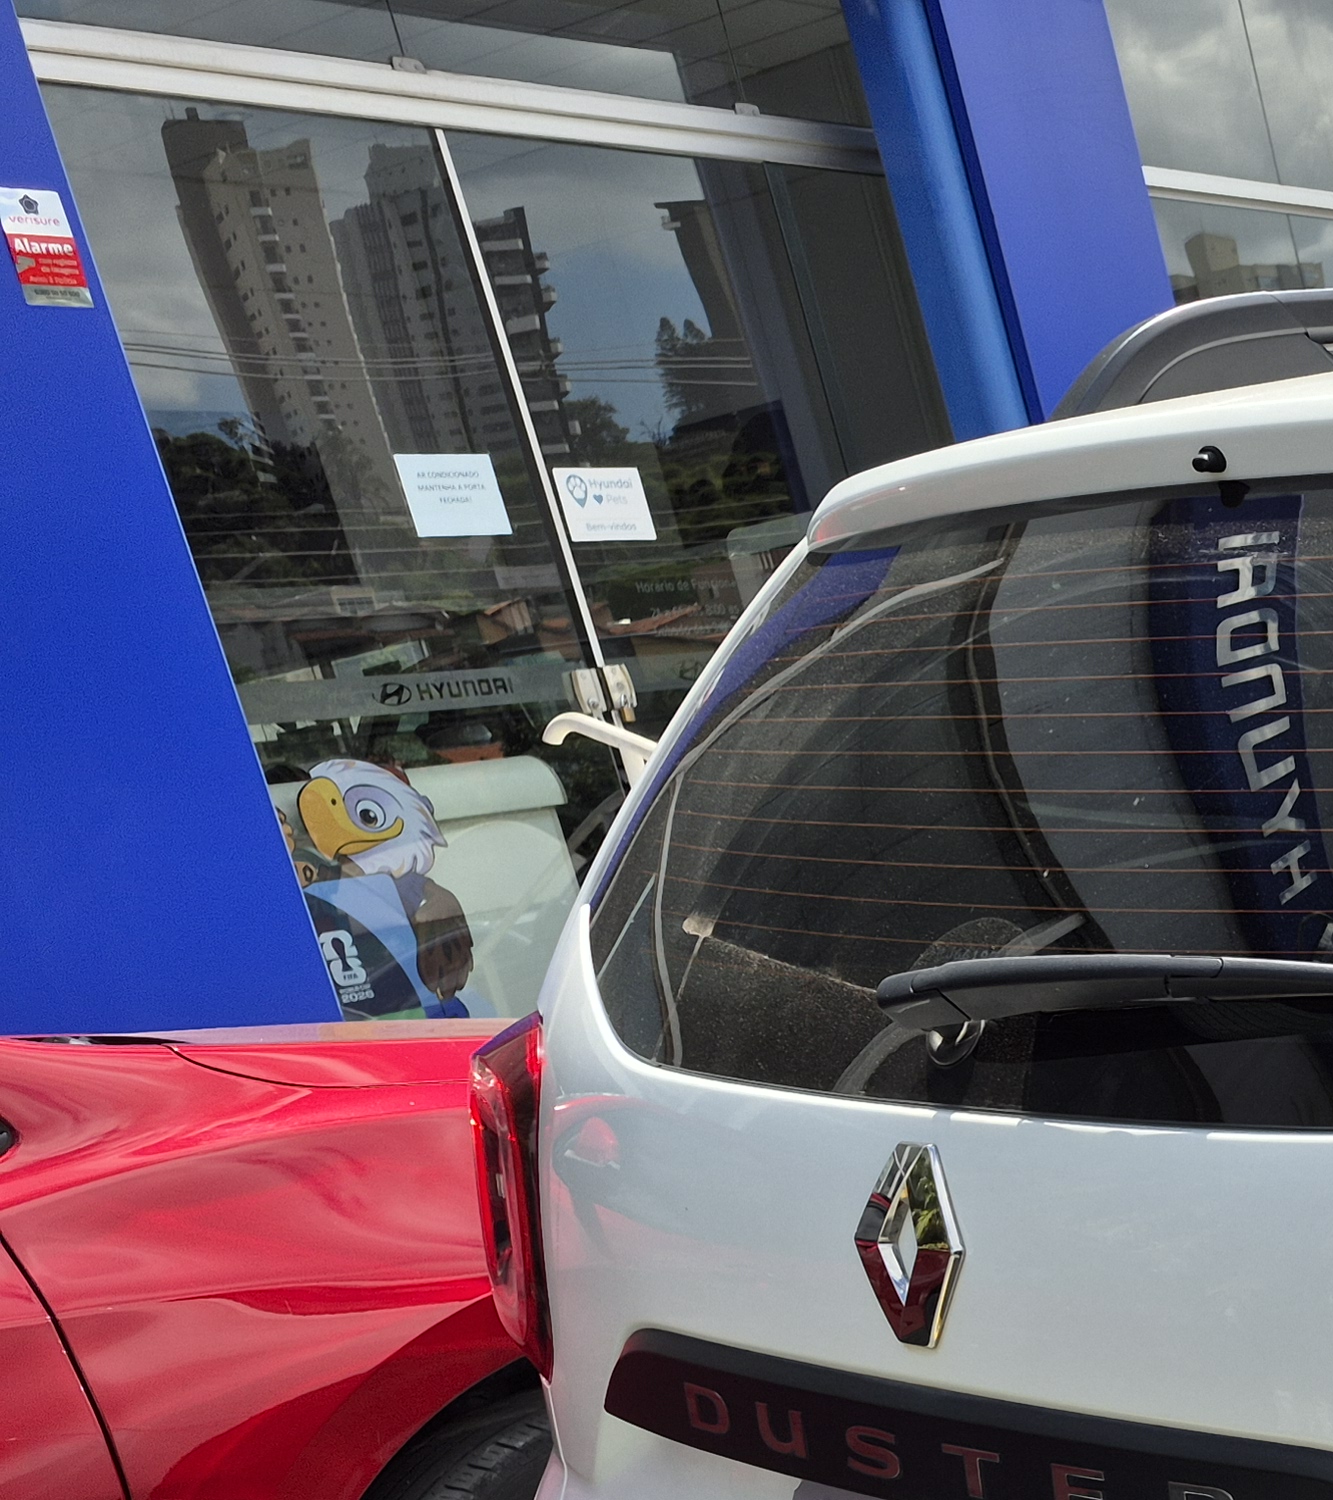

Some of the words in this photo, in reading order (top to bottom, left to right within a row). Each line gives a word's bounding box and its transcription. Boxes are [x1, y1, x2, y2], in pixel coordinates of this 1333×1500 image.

[8, 215, 60, 226] verisure
[14, 238, 74, 256] Alarme
[588, 478, 633, 490] Hyundai
[606, 494, 629, 504] Pets
[586, 522, 637, 531] Bem-vindos
[416, 677, 514, 700] HYUNDAI
